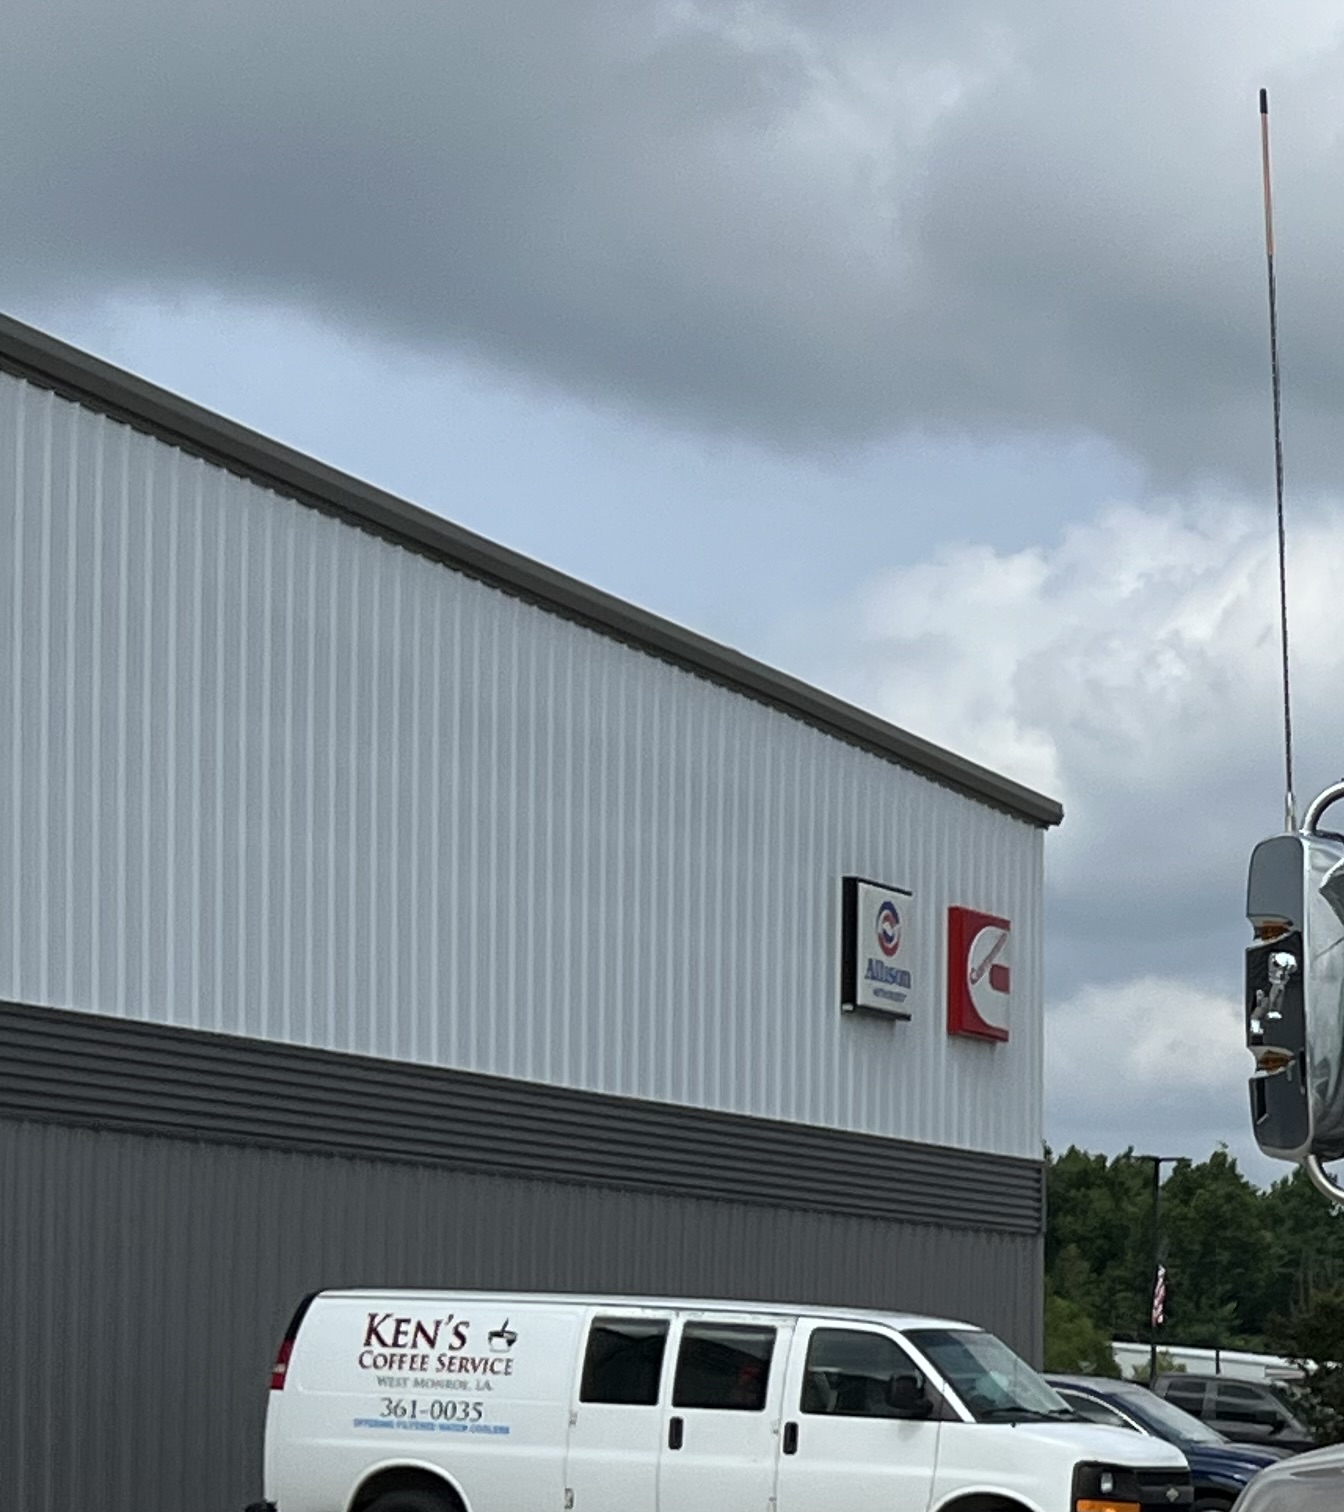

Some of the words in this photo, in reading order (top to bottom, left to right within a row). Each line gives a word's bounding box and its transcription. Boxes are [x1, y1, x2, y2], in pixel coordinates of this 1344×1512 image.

[363, 1312, 471, 1351] KEN'S
[358, 1350, 430, 1372] COFFEE
[435, 1352, 514, 1376] SERVICE
[376, 1375, 410, 1388] WEST
[380, 1397, 484, 1423] 361-0035
